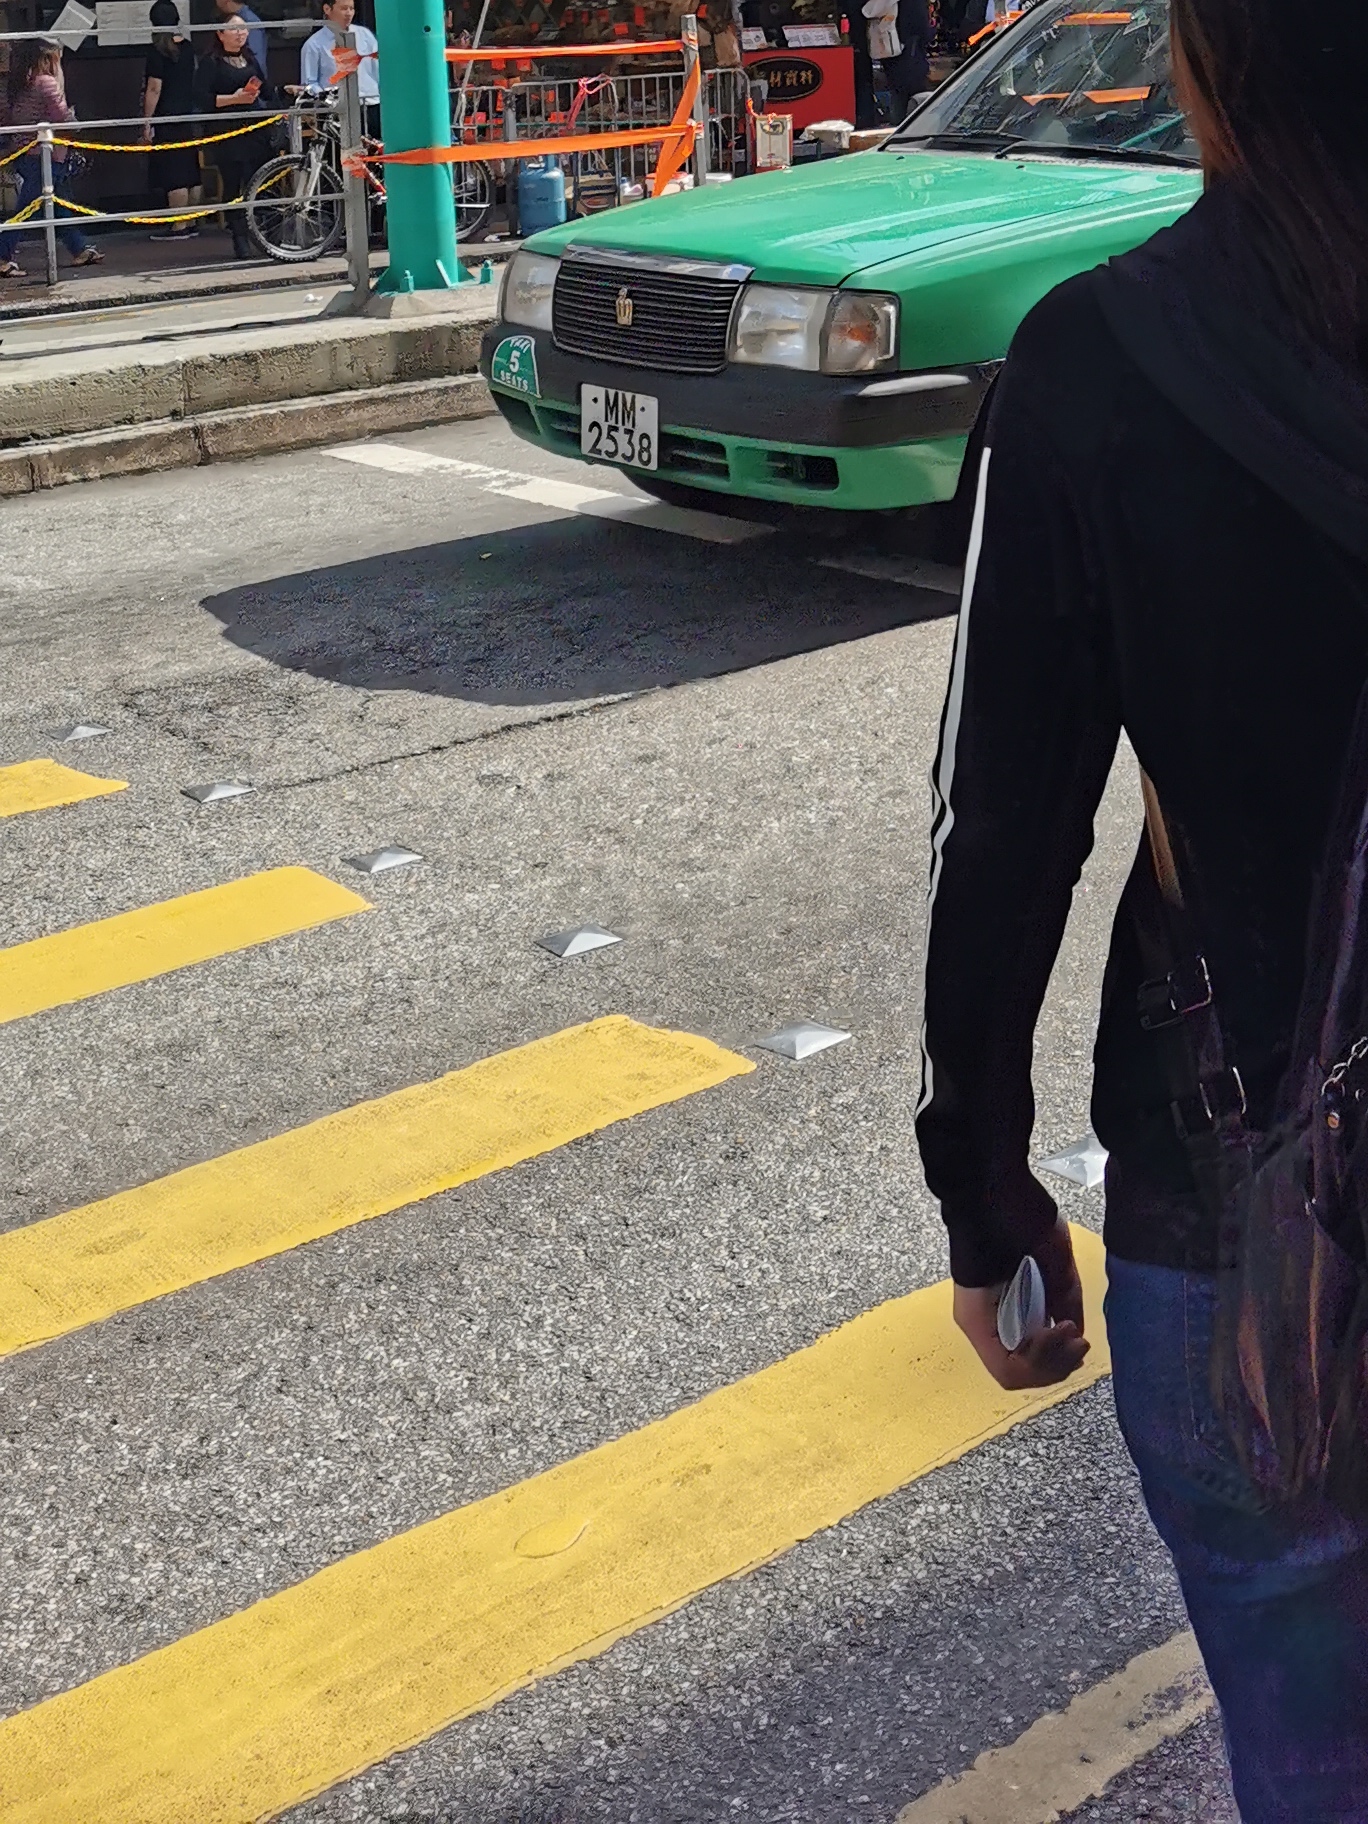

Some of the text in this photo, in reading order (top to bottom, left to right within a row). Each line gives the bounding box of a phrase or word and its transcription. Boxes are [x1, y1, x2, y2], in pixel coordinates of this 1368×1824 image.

[509, 350, 521, 374] 5
[500, 370, 529, 392] SEATS
[604, 389, 637, 428] MM
[588, 420, 652, 467] 2538
